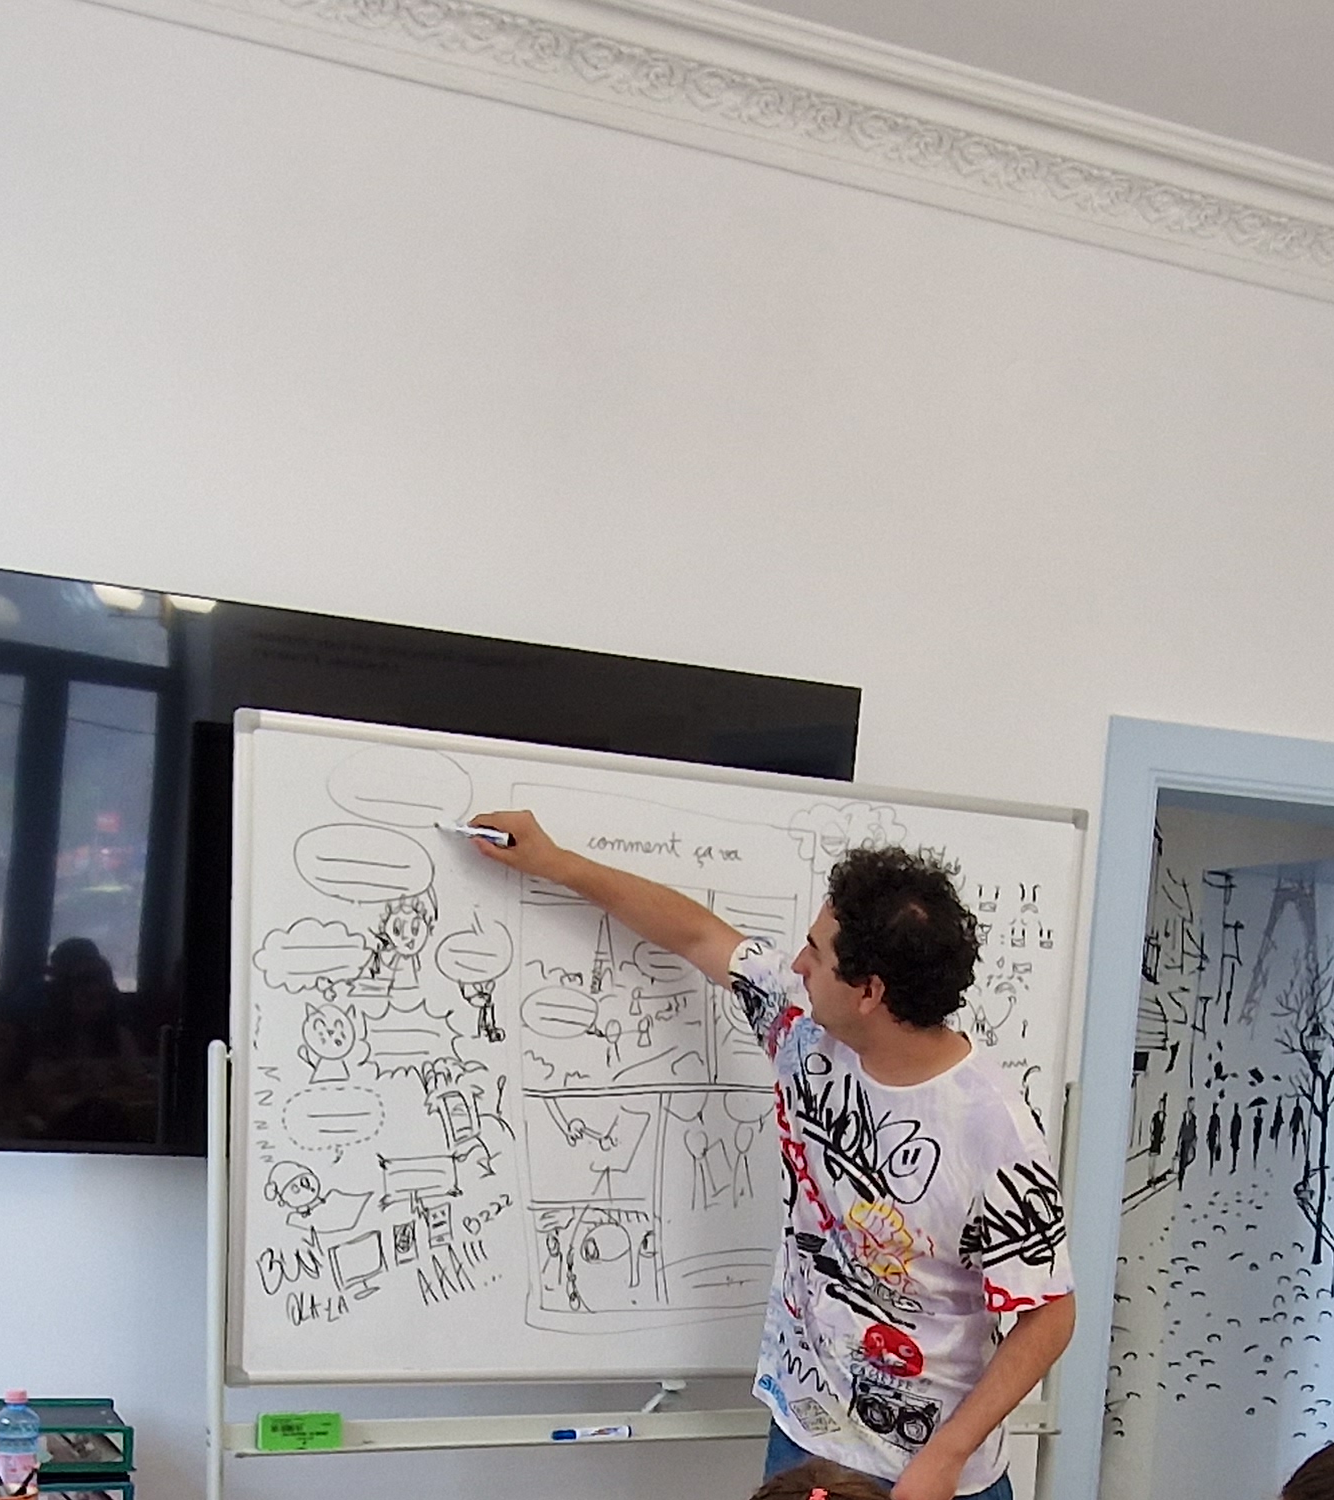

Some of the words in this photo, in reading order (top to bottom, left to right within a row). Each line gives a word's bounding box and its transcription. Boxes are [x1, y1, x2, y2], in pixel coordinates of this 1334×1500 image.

[586, 831, 682, 858] comment
[693, 844, 714, 868] ça
[719, 847, 743, 862] va
